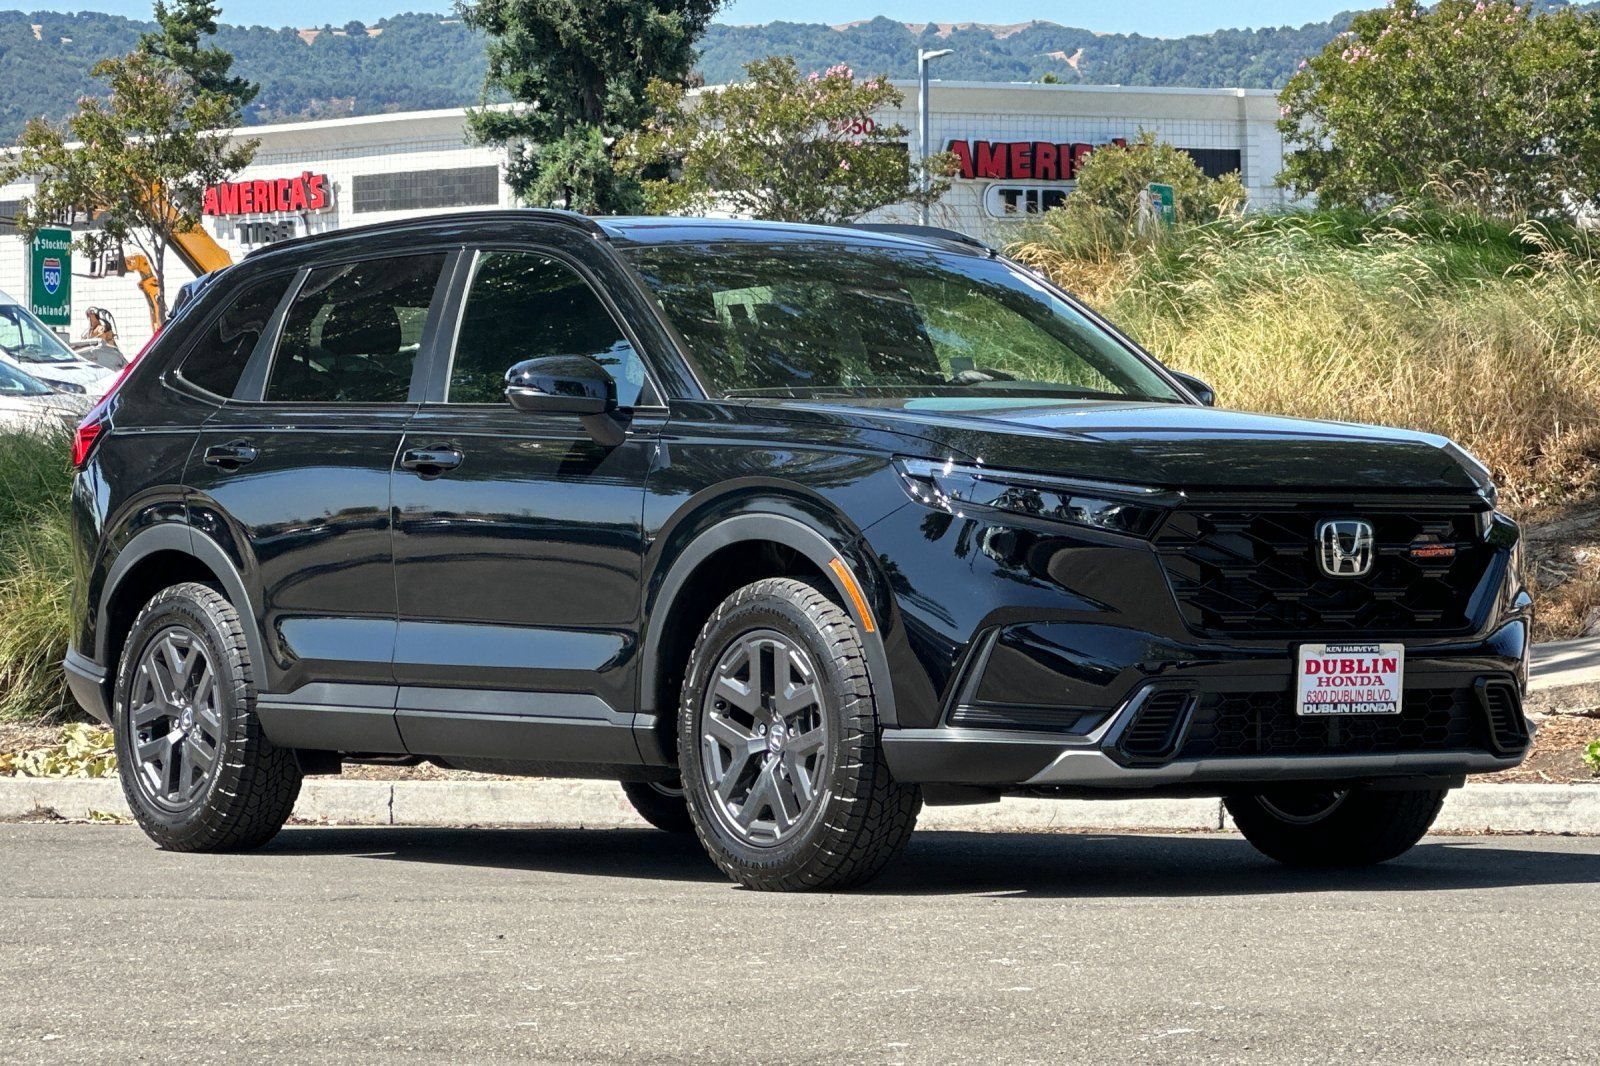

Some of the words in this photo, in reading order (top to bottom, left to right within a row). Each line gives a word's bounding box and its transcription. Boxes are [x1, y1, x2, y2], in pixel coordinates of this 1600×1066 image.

[947, 137, 1146, 181] AMERI'
[202, 171, 327, 216] AMERICA'S
[998, 188, 1067, 214] TIR
[236, 220, 293, 244] TIRE
[44, 271, 60, 286] 580
[33, 304, 63, 316] Oakland
[1342, 645, 1379, 653] HARVEY'S
[1305, 658, 1398, 675] DUBLIN
[1316, 675, 1385, 688] HONDA
[1306, 690, 1328, 703] 6300
[1330, 689, 1364, 702] DUBLIN
[1366, 689, 1393, 701] BLVD.
[1303, 703, 1350, 714] DUBLIN
[1351, 702, 1396, 713] HONDA
